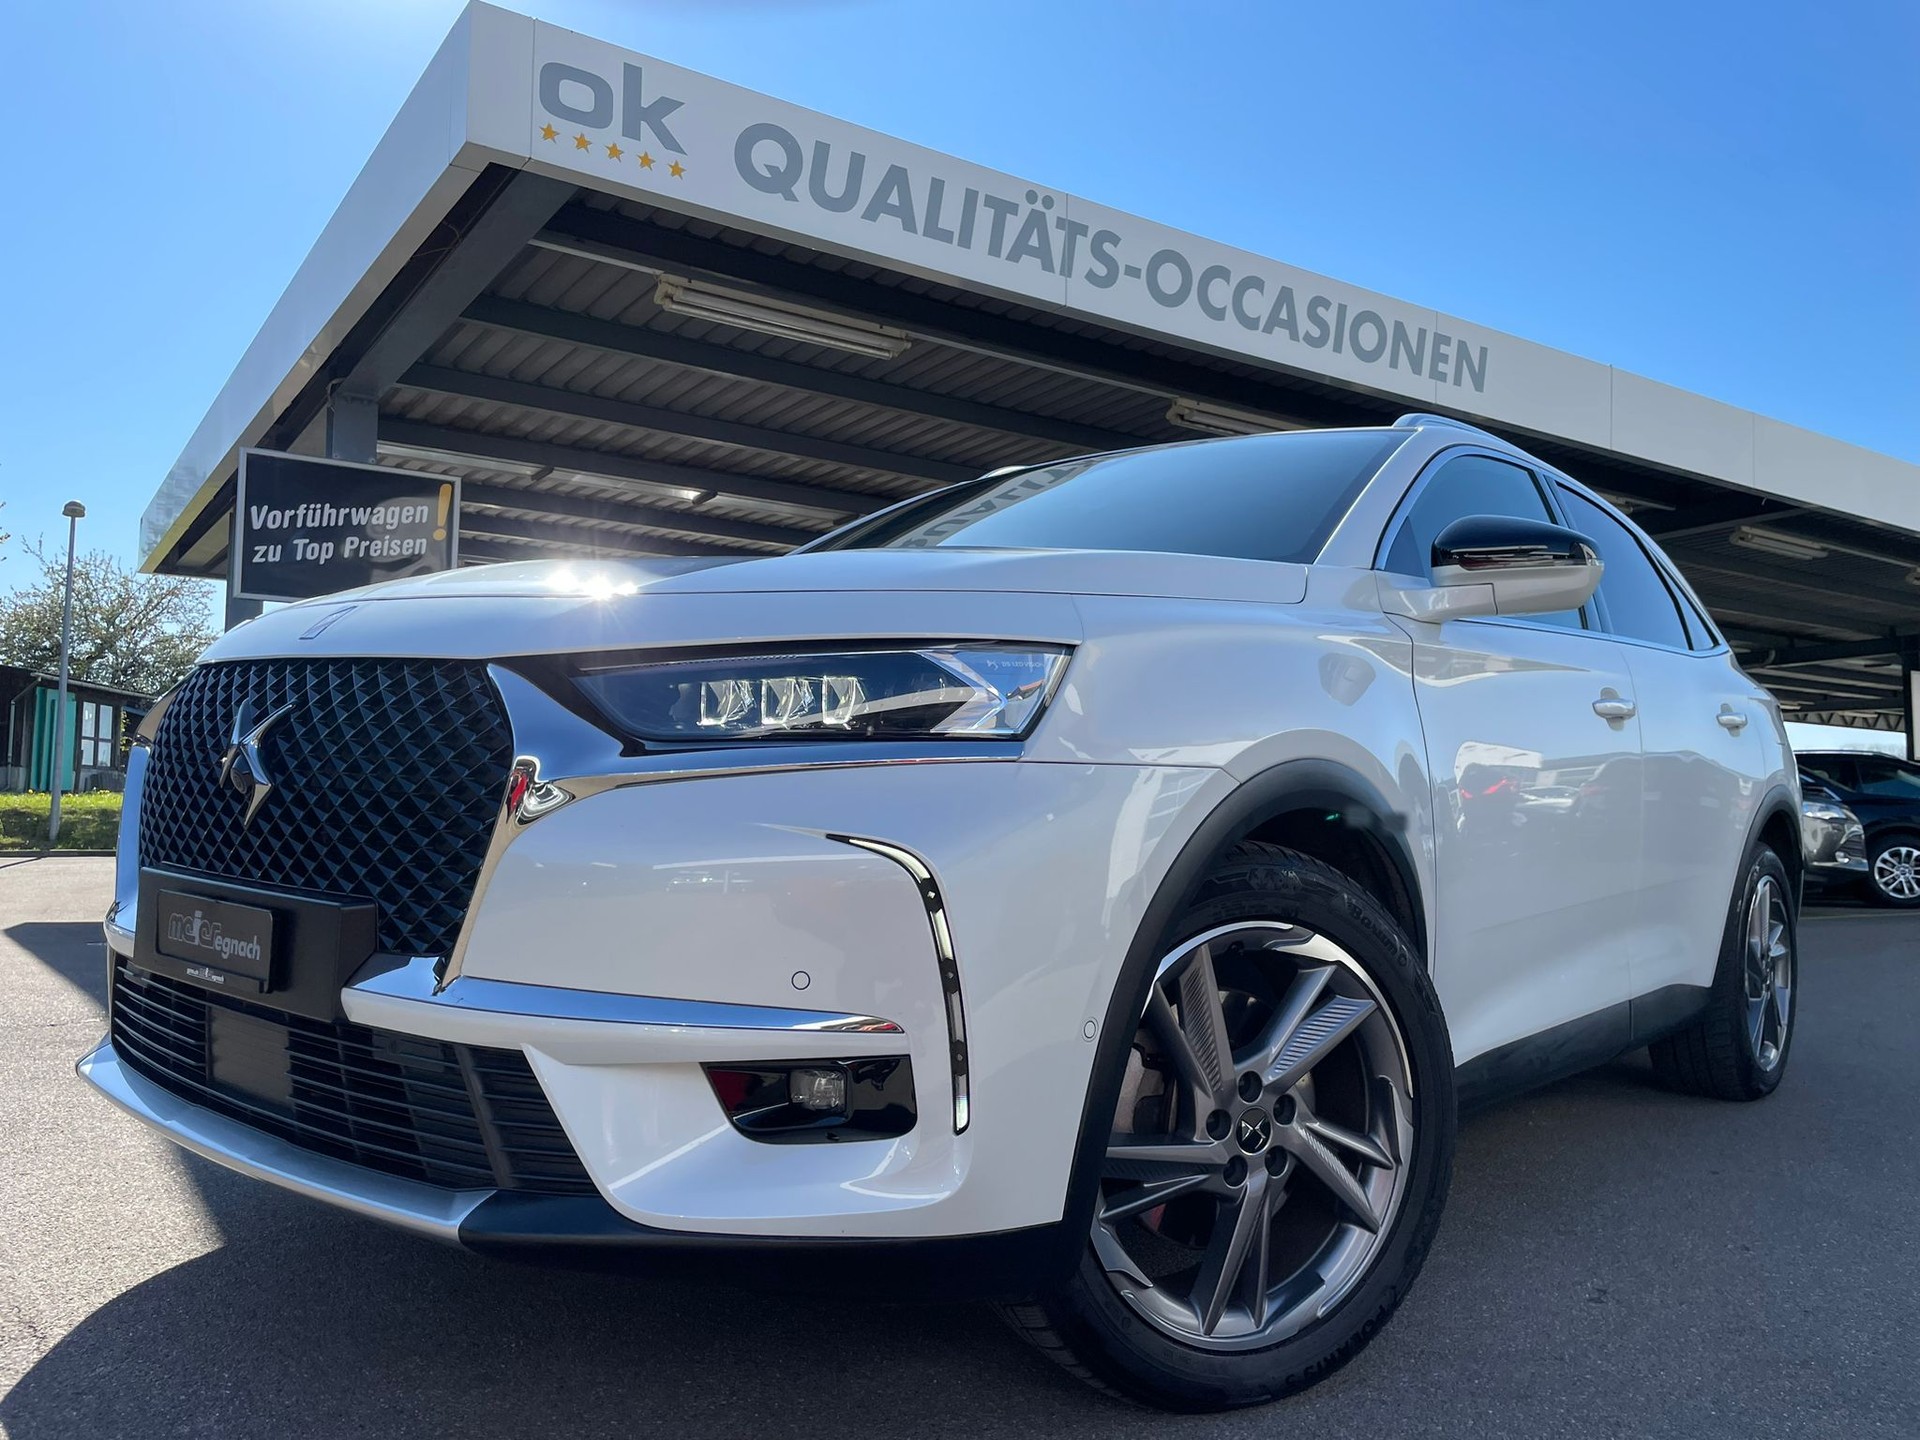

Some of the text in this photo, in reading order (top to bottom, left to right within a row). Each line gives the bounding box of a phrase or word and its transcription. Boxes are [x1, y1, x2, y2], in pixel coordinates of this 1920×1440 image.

[540, 62, 1488, 393] ok QUALITÄTS-OCCASIONEN
[250, 503, 429, 530] Vorführwagen
[252, 535, 428, 565] zu Top Preisen
[214, 935, 261, 961] egnach
